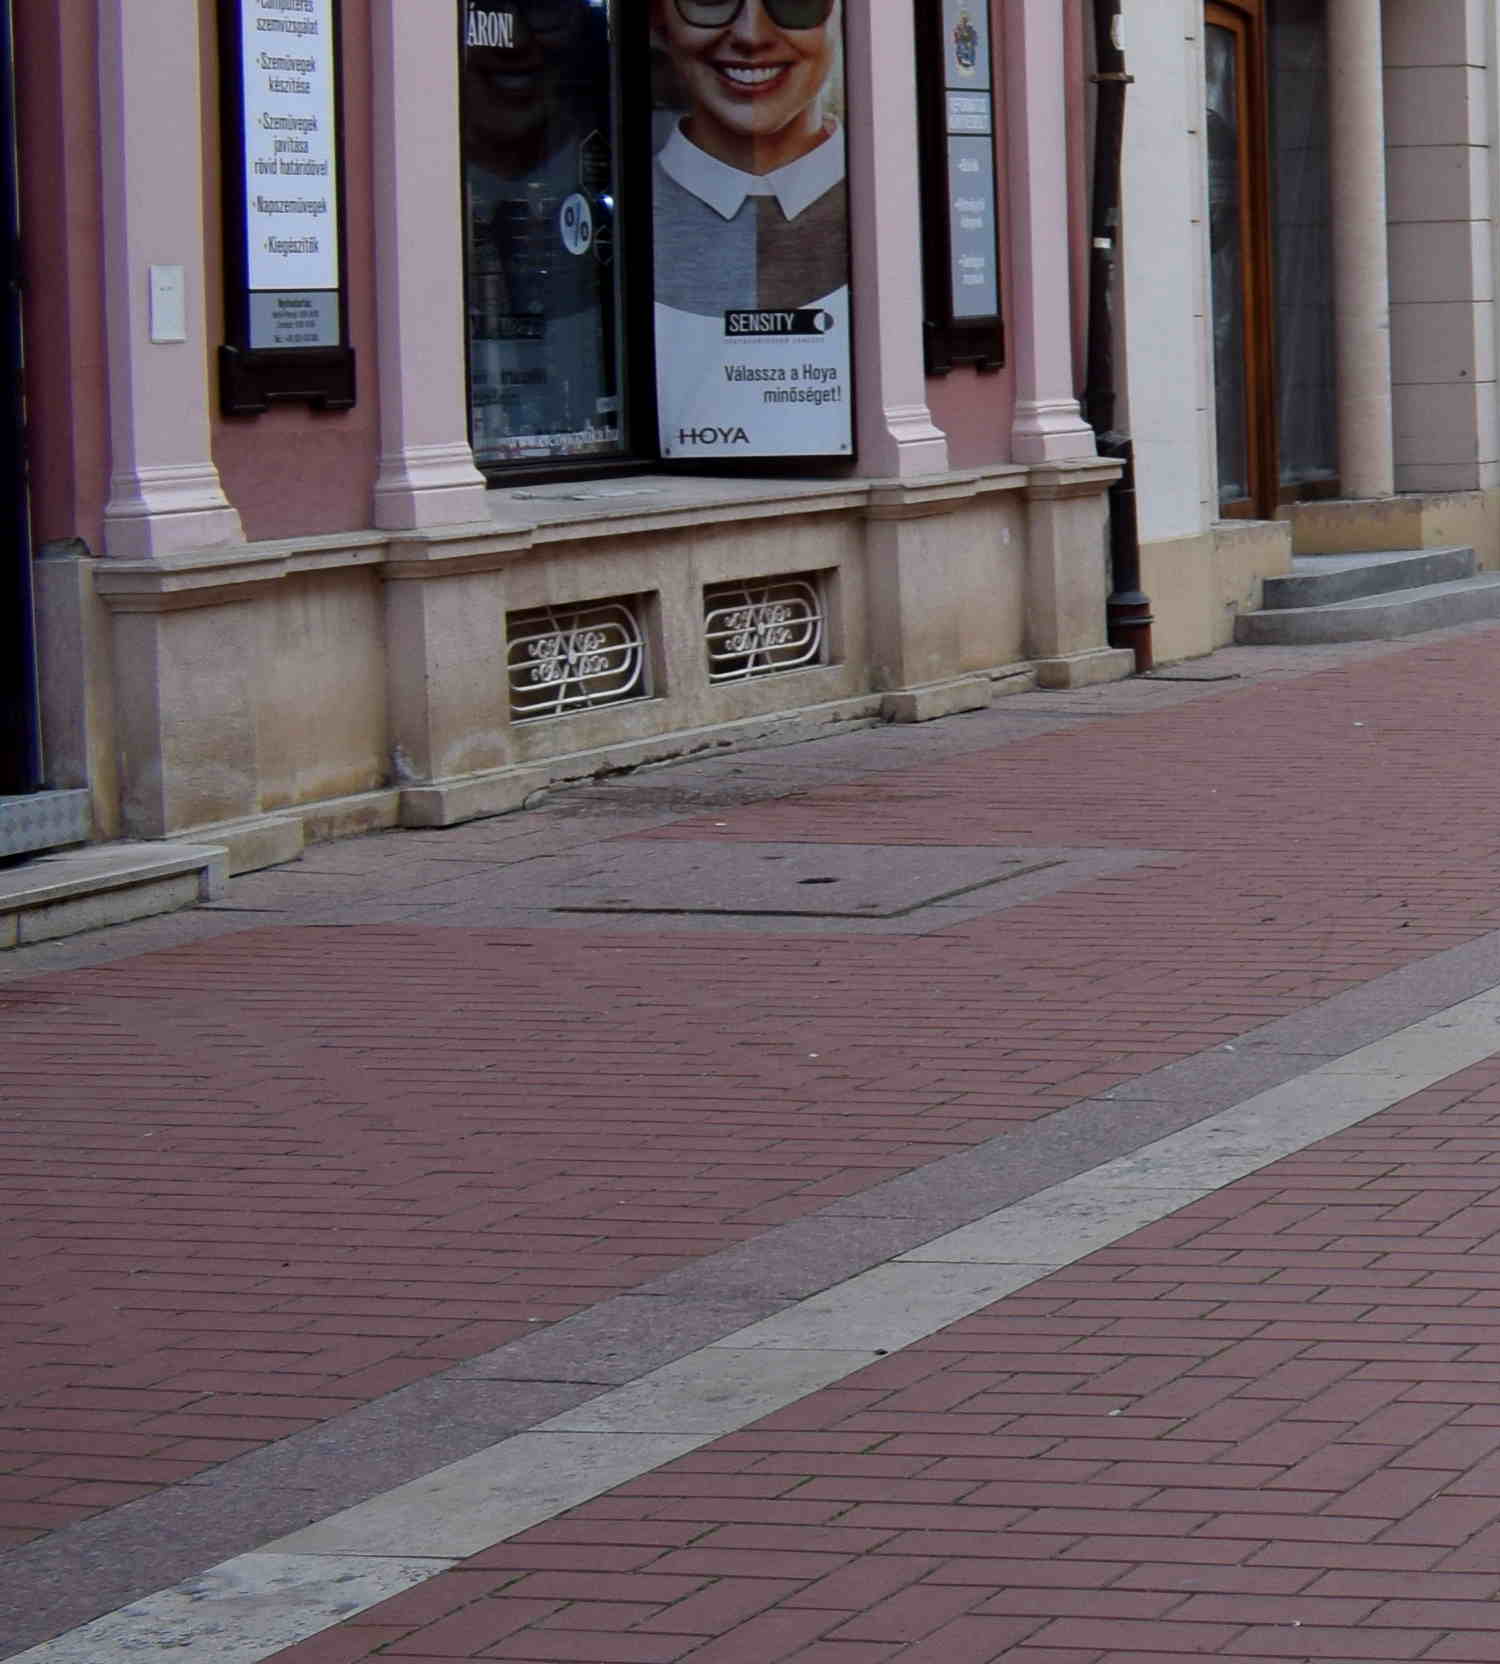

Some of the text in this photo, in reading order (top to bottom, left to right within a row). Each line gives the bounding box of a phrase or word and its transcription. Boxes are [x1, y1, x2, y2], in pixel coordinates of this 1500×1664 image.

[729, 312, 795, 332] SENSITY
[724, 364, 837, 383] Válassza a Hoya
[763, 387, 841, 405] minőséget!
[679, 427, 749, 445] HOYA
